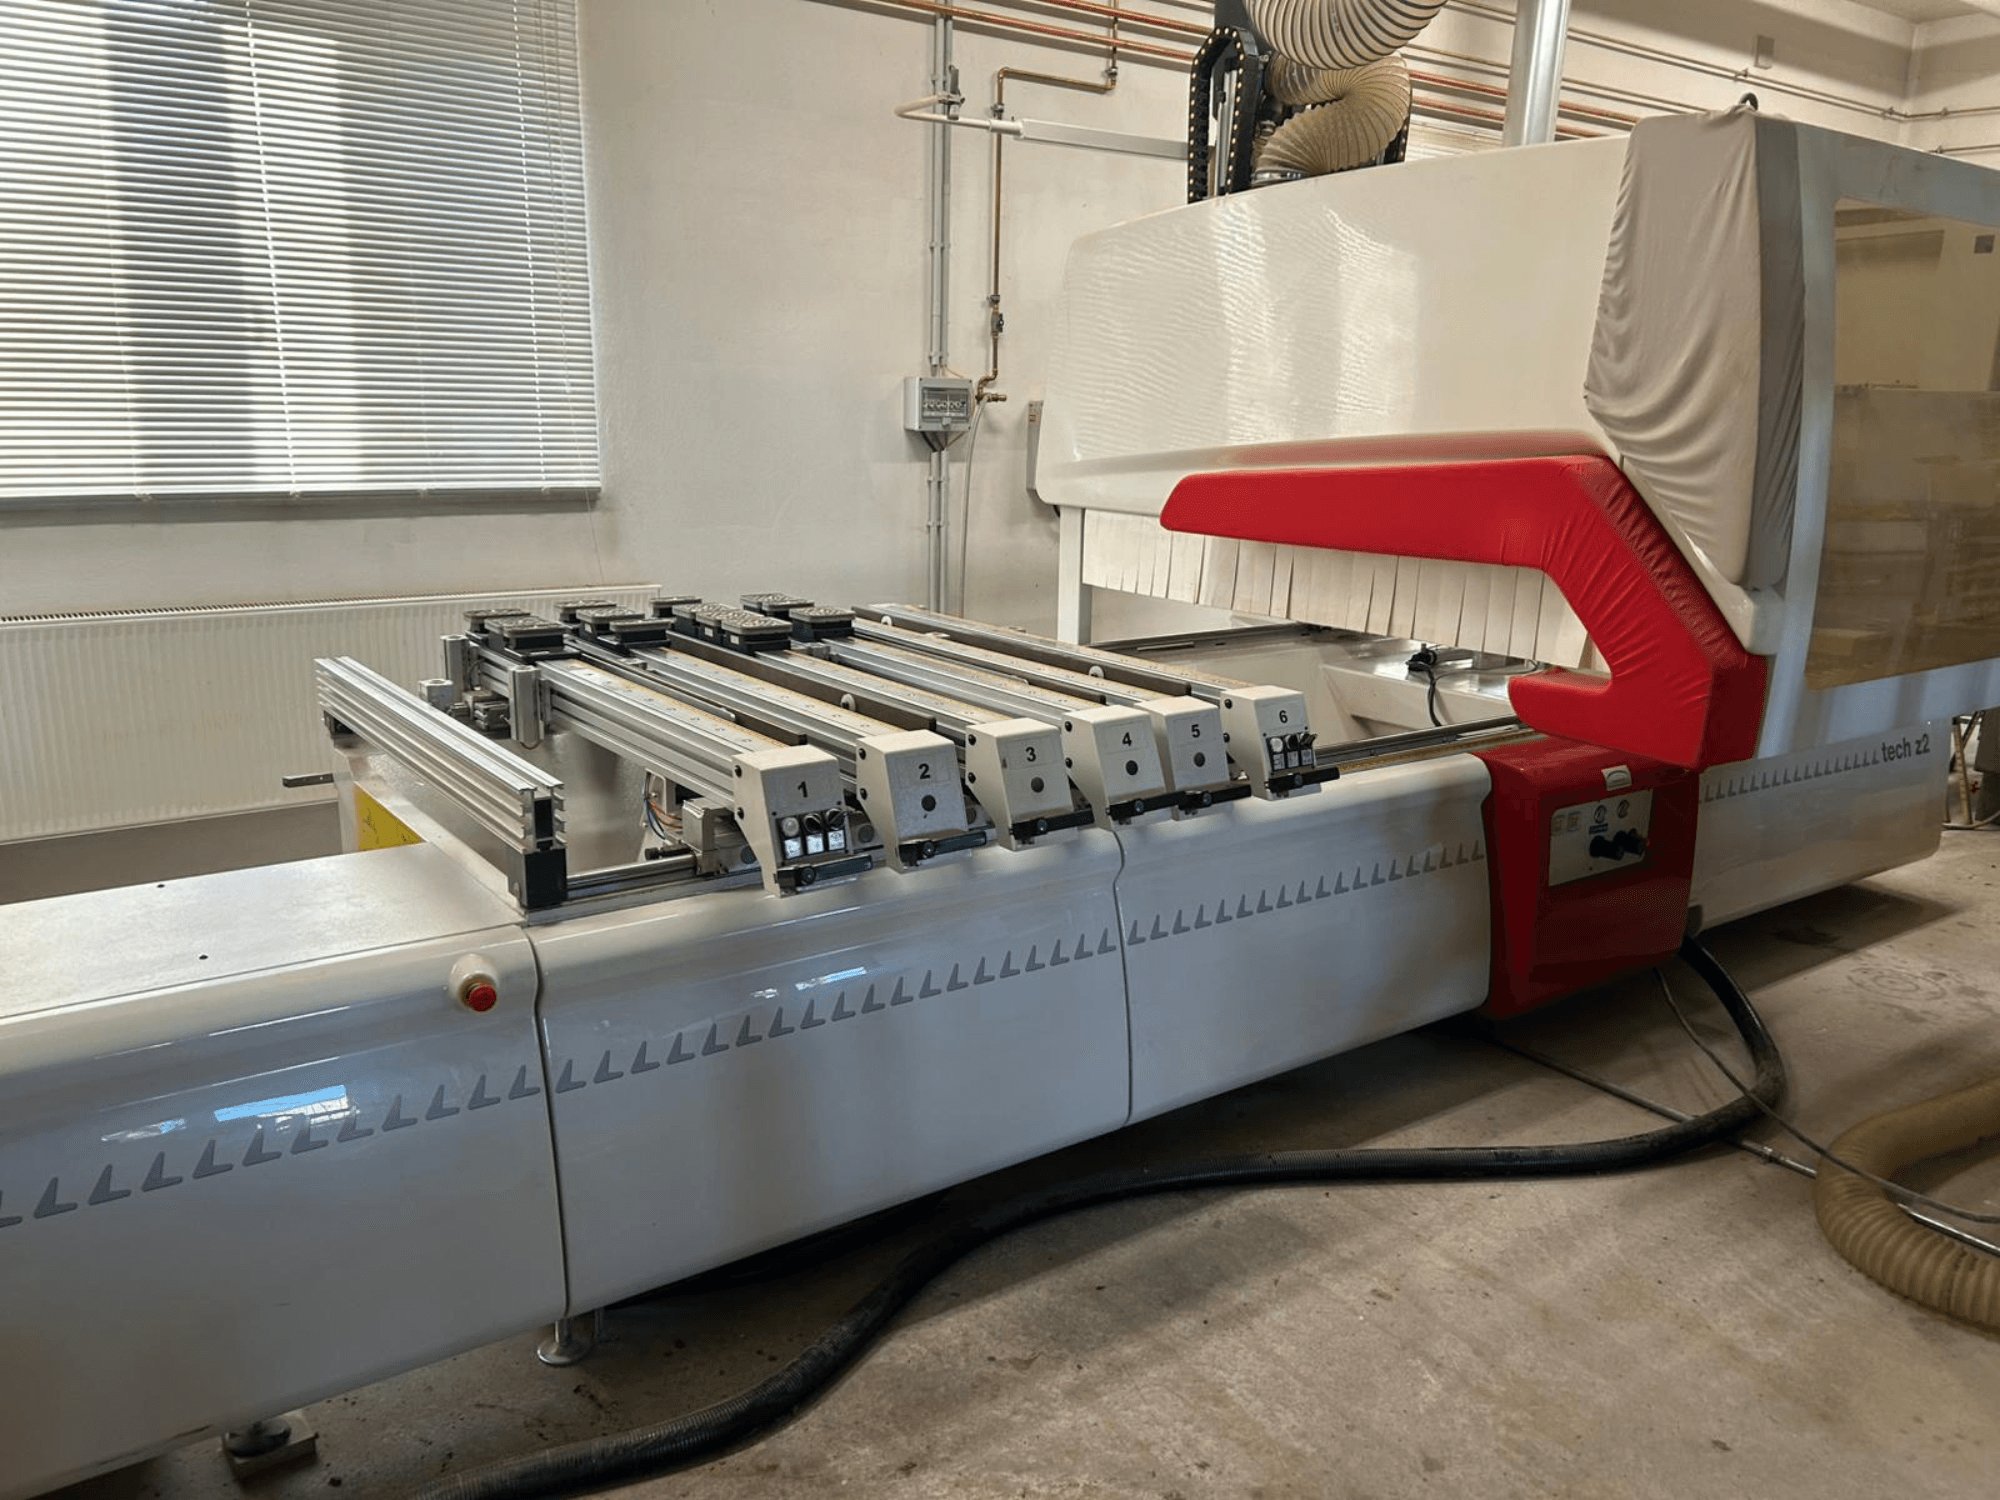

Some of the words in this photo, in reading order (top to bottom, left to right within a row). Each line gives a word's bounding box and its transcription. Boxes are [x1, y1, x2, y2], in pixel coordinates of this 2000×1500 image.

[1279, 709, 1289, 724] 6
[1122, 732, 1133, 747] 4
[1191, 724, 1201, 739] 5
[1025, 746, 1037, 762] 3
[1881, 737, 1911, 762] tech
[918, 763, 931, 780] 2
[797, 780, 808, 798] 1
